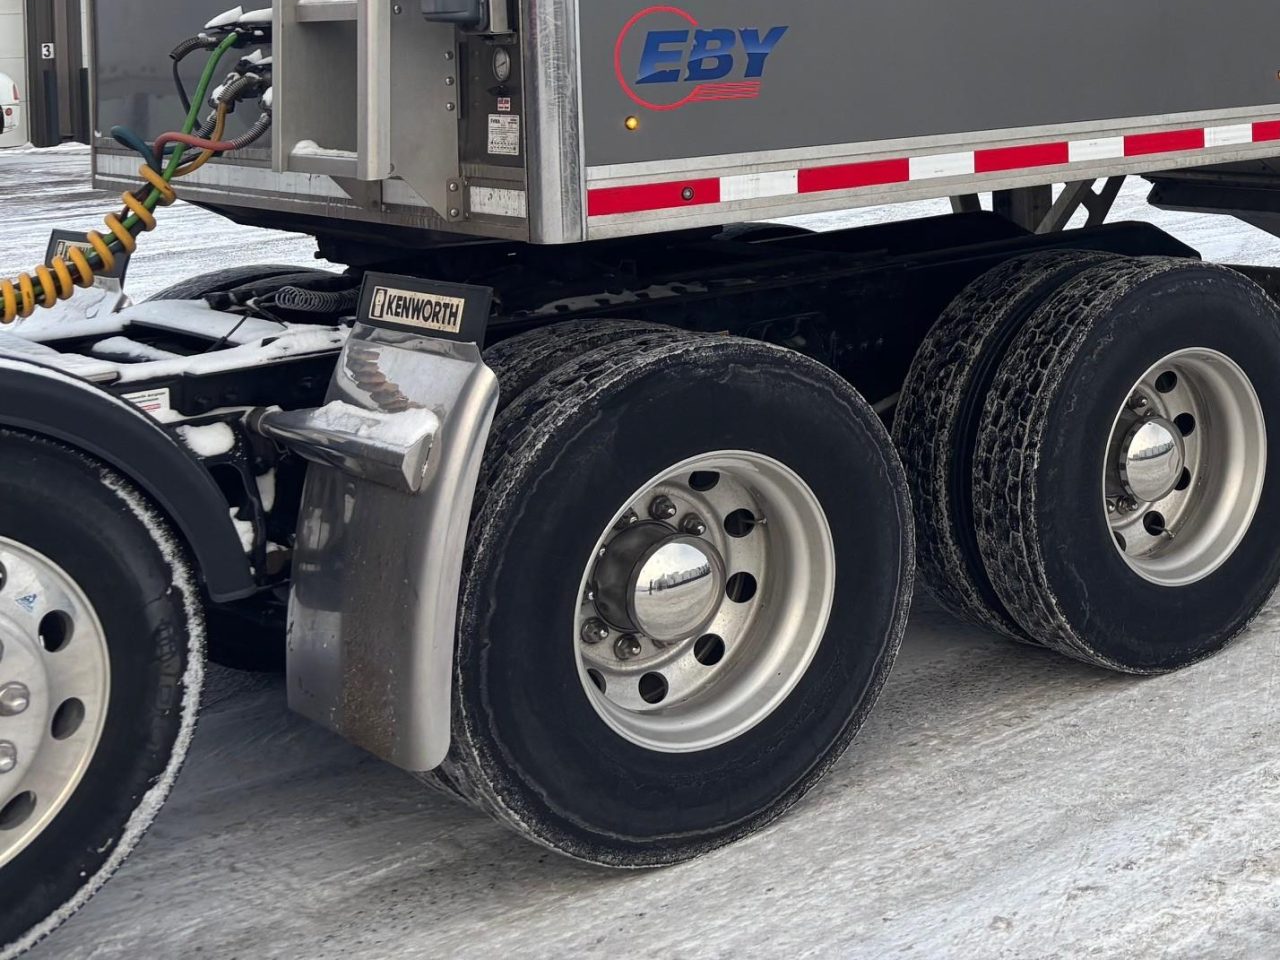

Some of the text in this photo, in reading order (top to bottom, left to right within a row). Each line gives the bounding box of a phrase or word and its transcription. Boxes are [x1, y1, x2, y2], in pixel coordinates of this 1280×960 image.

[43, 44, 51, 58] 3
[634, 25, 790, 85] EBY
[386, 294, 460, 326] KENWORTH
